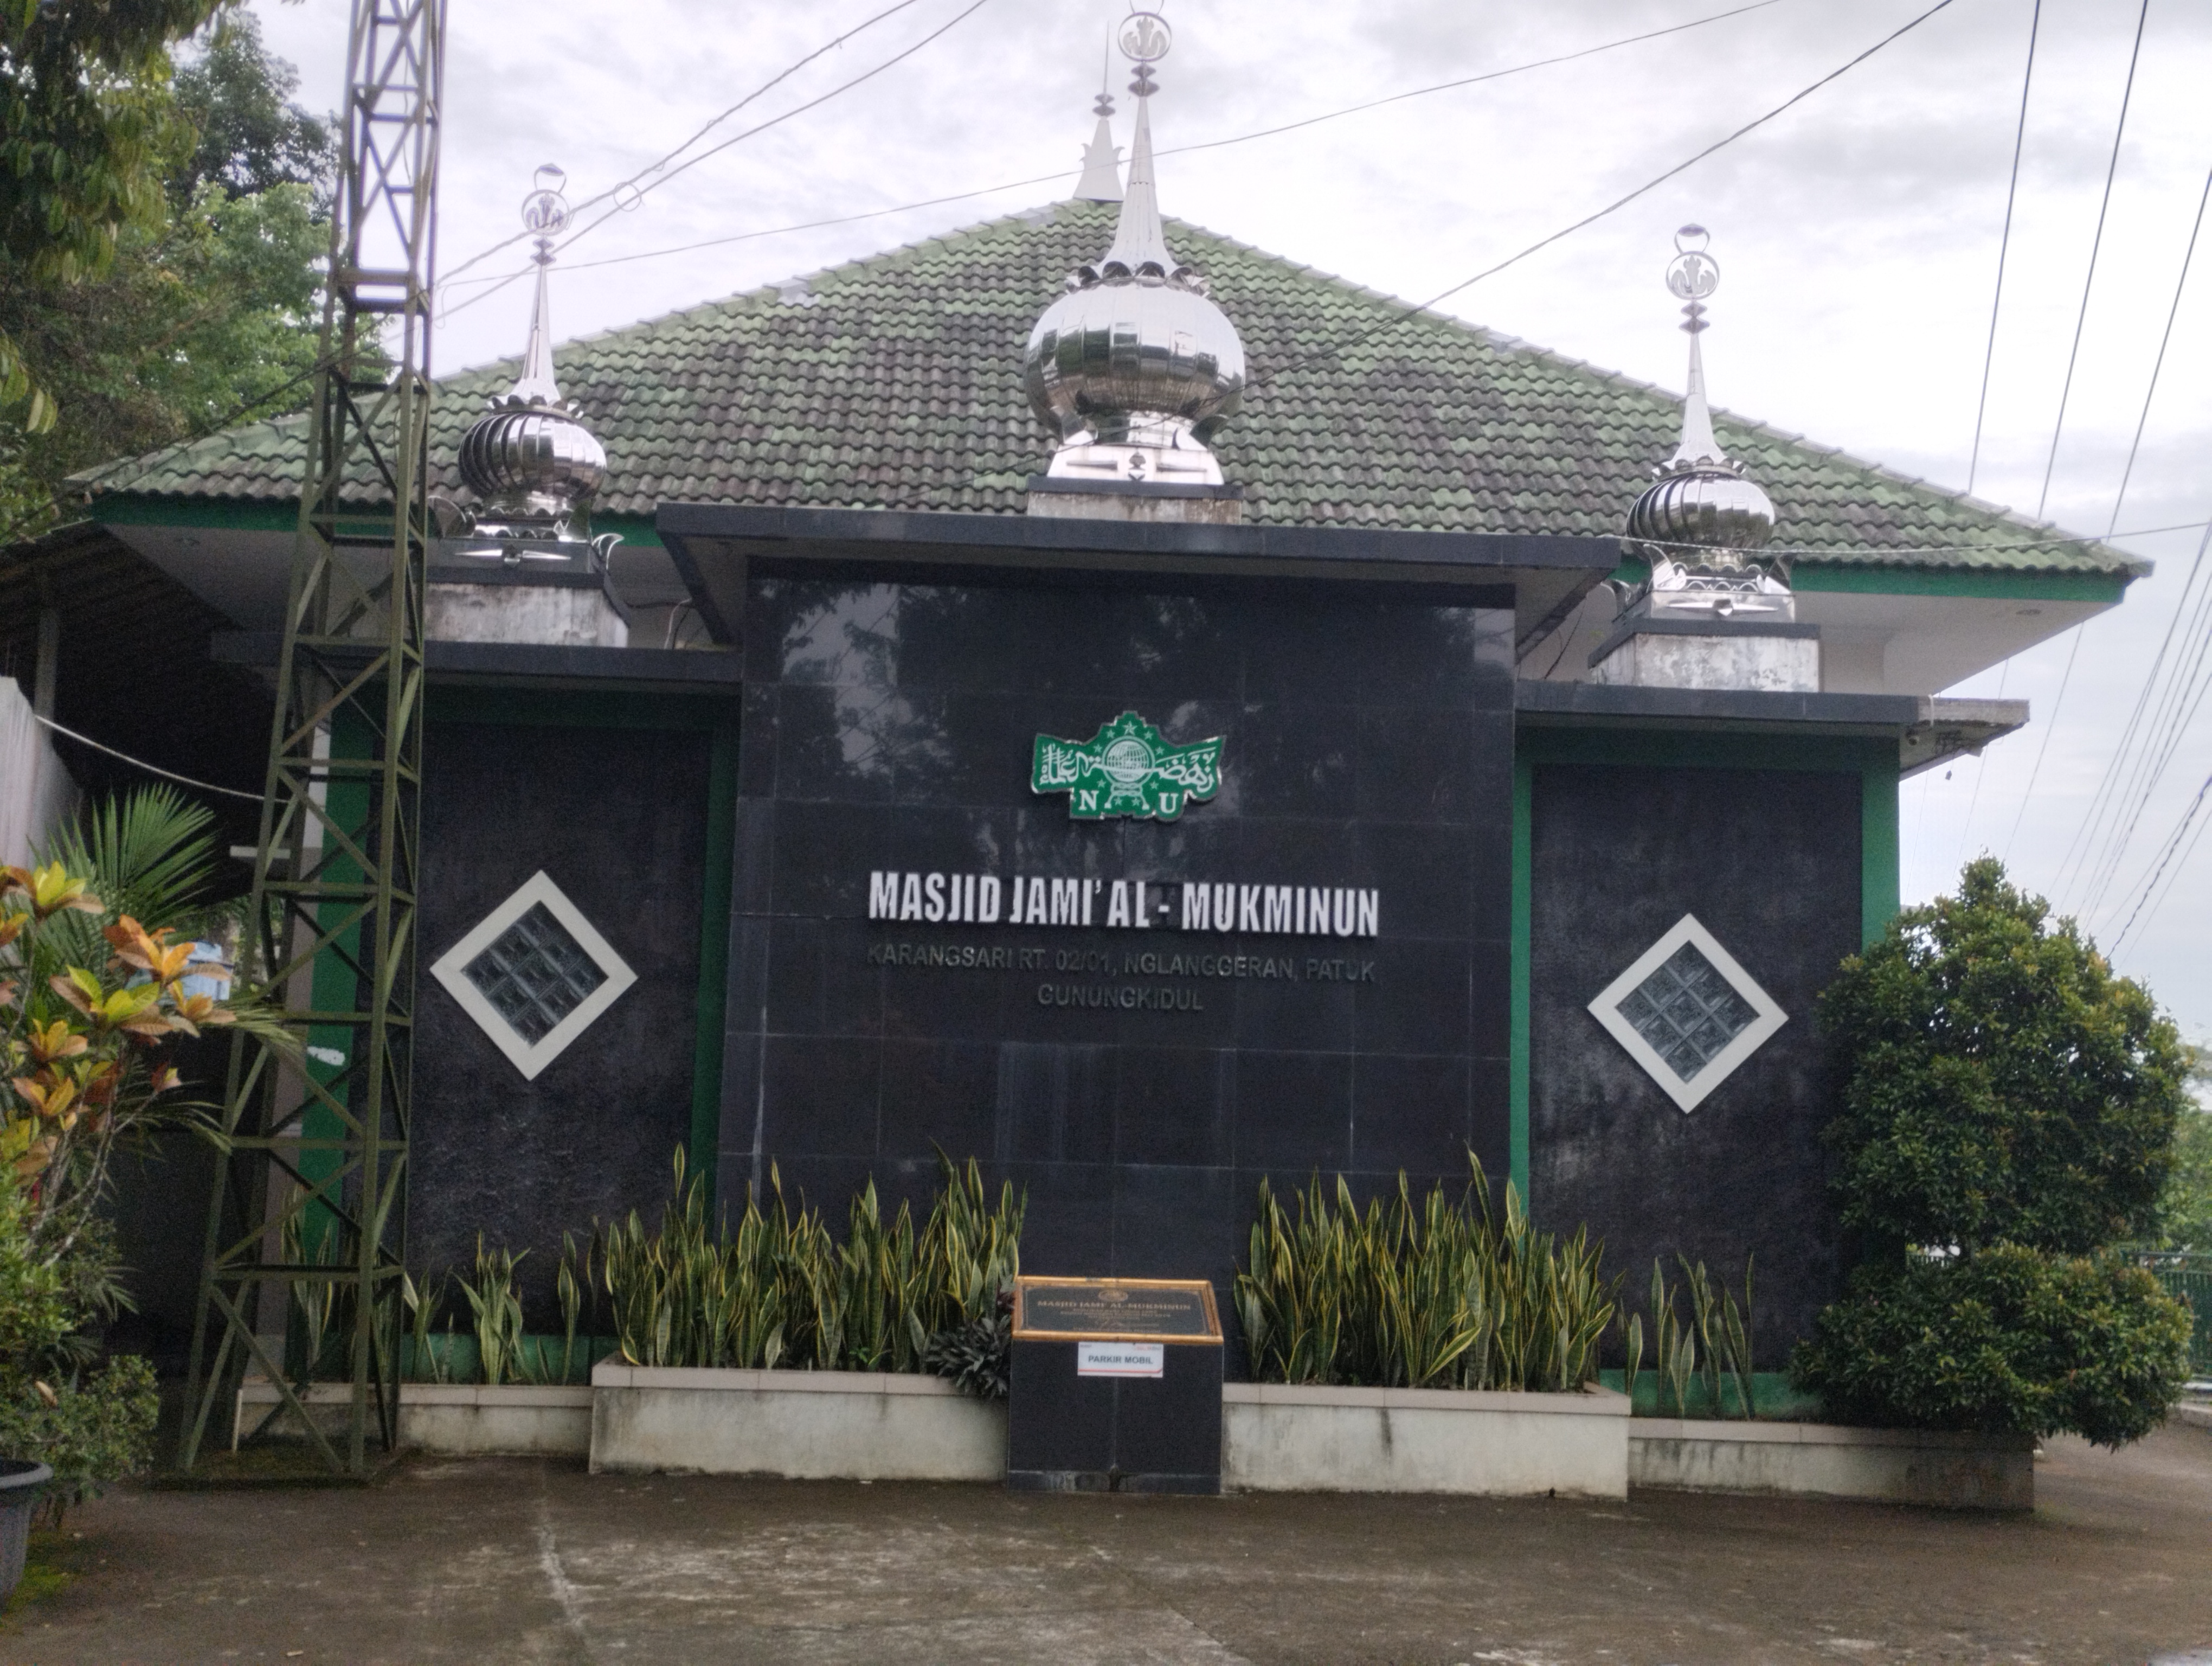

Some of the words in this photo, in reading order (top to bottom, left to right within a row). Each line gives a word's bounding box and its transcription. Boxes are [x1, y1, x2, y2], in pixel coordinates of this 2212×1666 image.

[1079, 790, 1099, 811] N
[1158, 792, 1179, 813] U
[869, 871, 1001, 922] MASJID
[1106, 880, 1150, 927] AL
[1181, 882, 1379, 937] MUKMINUN
[867, 943, 1013, 968] KARANGSARI
[1019, 948, 1049, 970] RT.
[1056, 950, 1117, 977] 02/01,
[1124, 952, 1298, 982] NGLANGGERAN,
[1306, 958, 1375, 982] PATUK
[1037, 983, 1204, 1010] GUNUNGKIDUL
[1088, 1355, 1122, 1363] PARKIR
[1124, 1356, 1153, 1364] MOBIL
